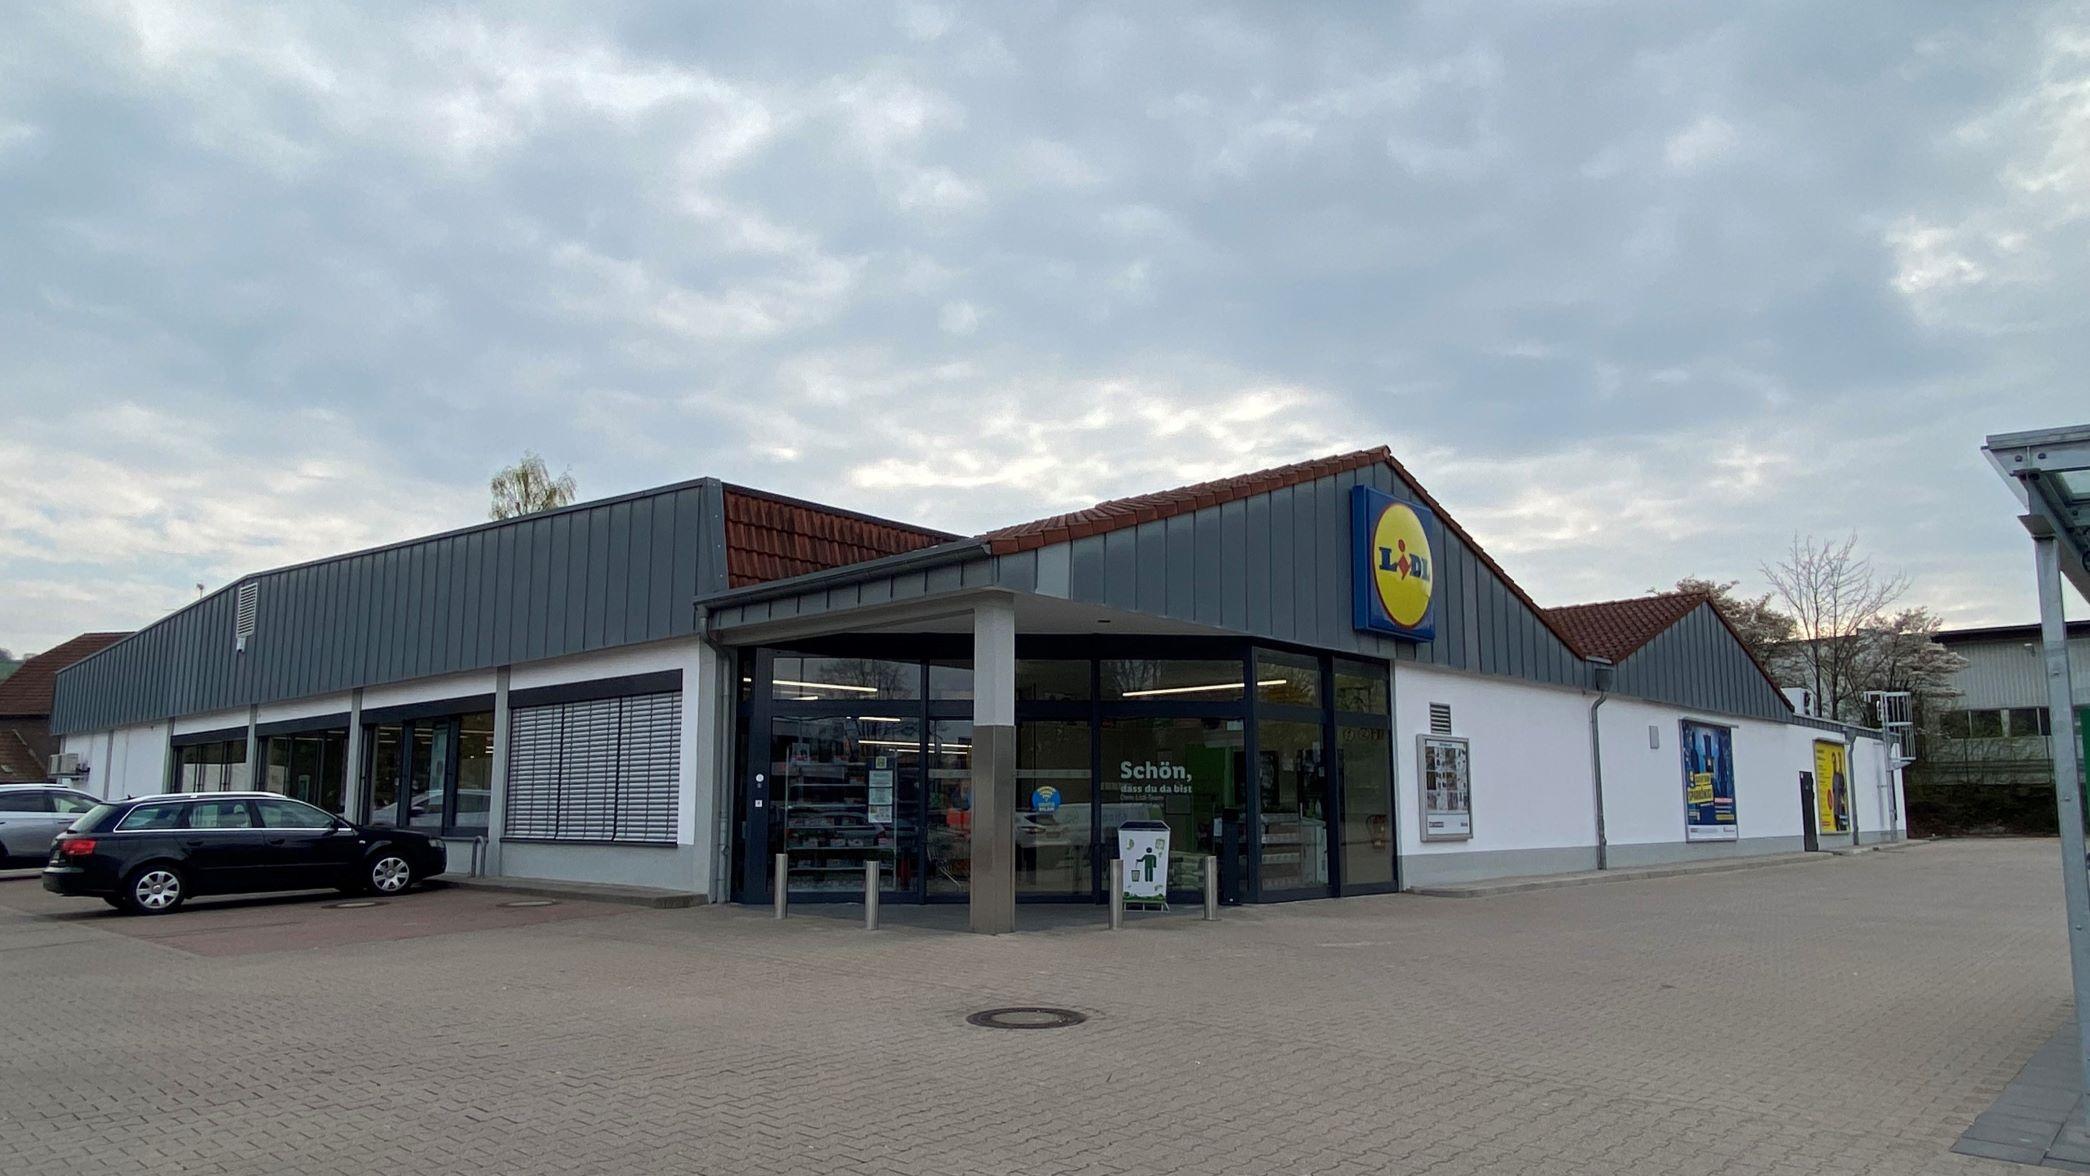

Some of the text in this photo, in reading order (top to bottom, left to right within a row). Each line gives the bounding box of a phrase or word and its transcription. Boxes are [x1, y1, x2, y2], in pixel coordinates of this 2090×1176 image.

[1120, 761, 1192, 782] Schön,
[1121, 784, 1193, 793] dass du da bist
